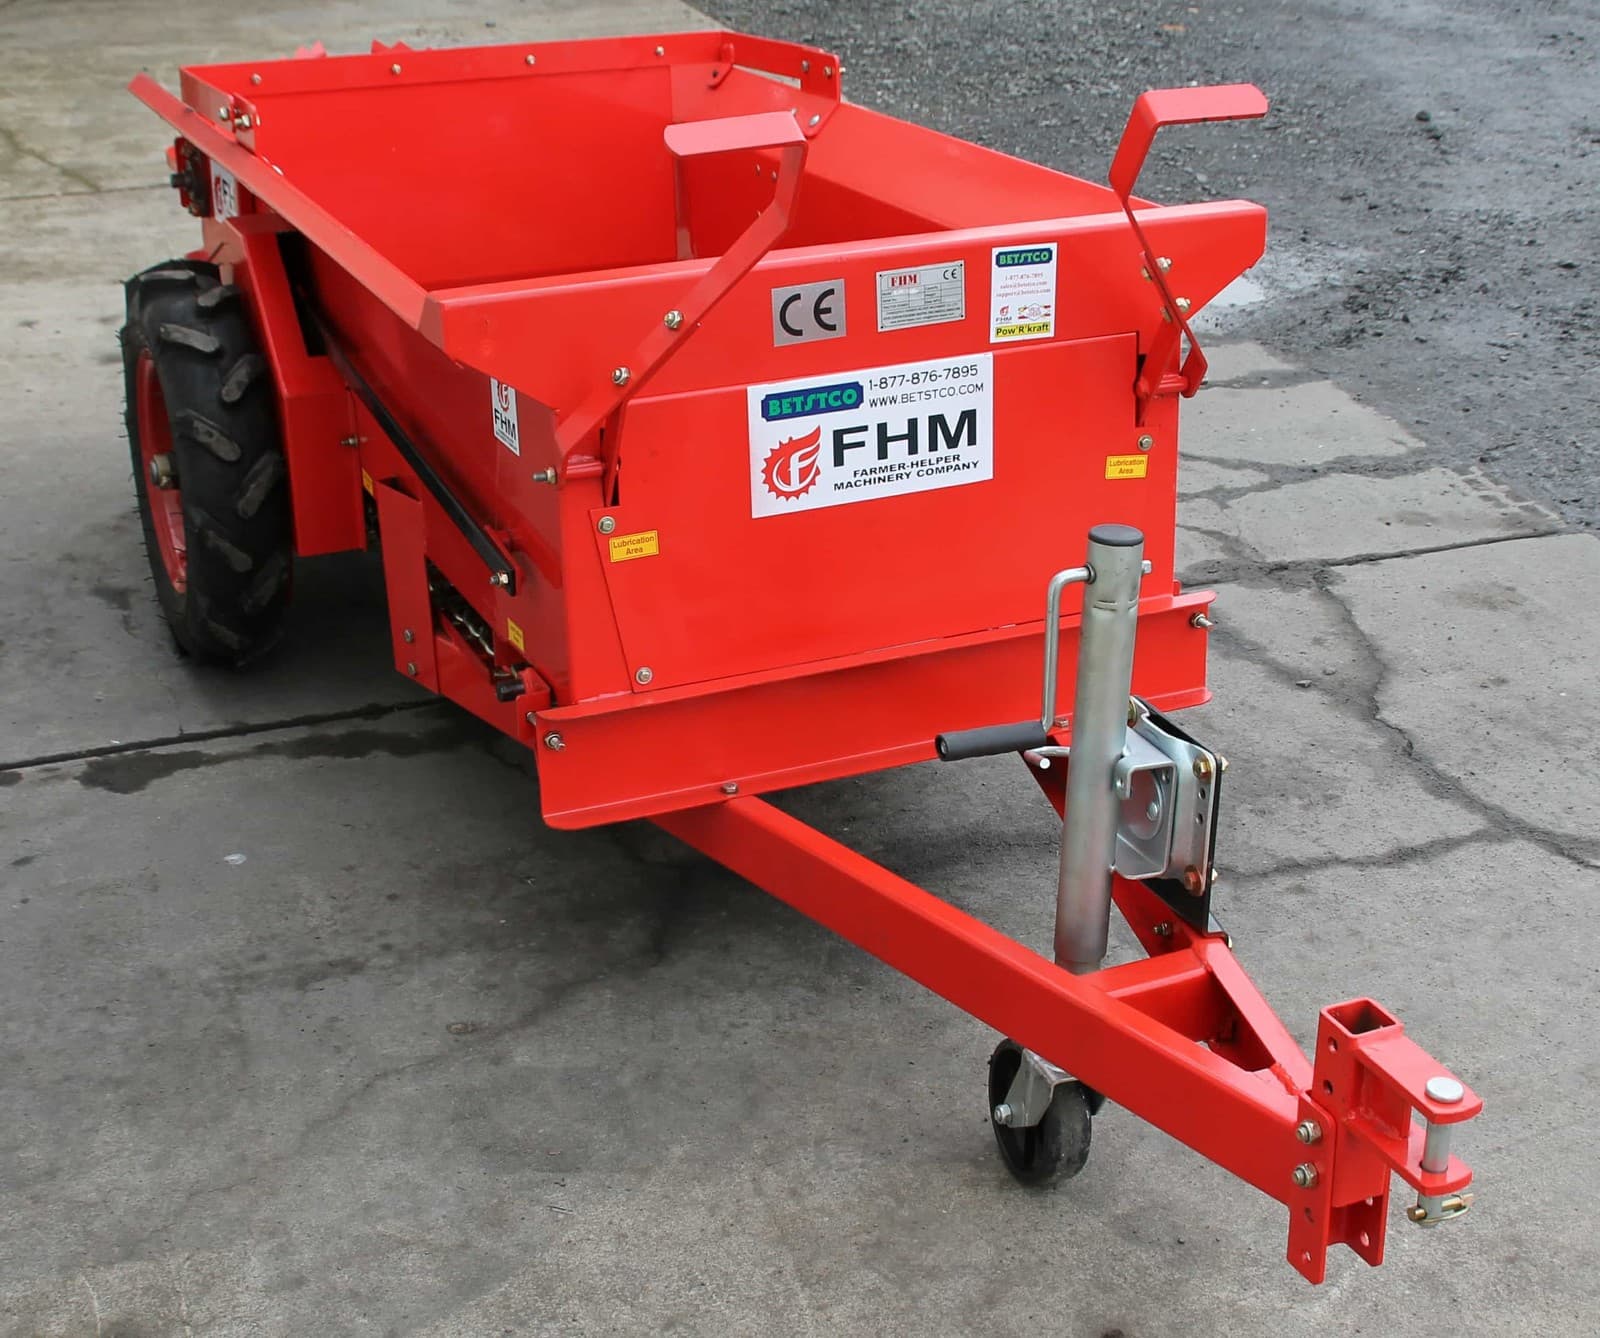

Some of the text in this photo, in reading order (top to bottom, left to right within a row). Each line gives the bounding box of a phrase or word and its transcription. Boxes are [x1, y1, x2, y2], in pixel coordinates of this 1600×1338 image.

[999, 251, 1049, 265] BETSTCO
[891, 274, 918, 288] FHM
[779, 288, 837, 337] CE
[868, 364, 979, 391] 1-877-876-7895
[767, 389, 858, 418] BETSTCO
[868, 383, 985, 408] WWW.BETSTCO.COM
[494, 407, 517, 441] FHM
[832, 408, 978, 468] FHM
[853, 454, 961, 479] FARMER-HELPER
[1110, 459, 1145, 467] Lubrication
[833, 460, 980, 492] MACHINERY COMPANY
[613, 535, 655, 549] Lubrication
[626, 547, 644, 556] Area
